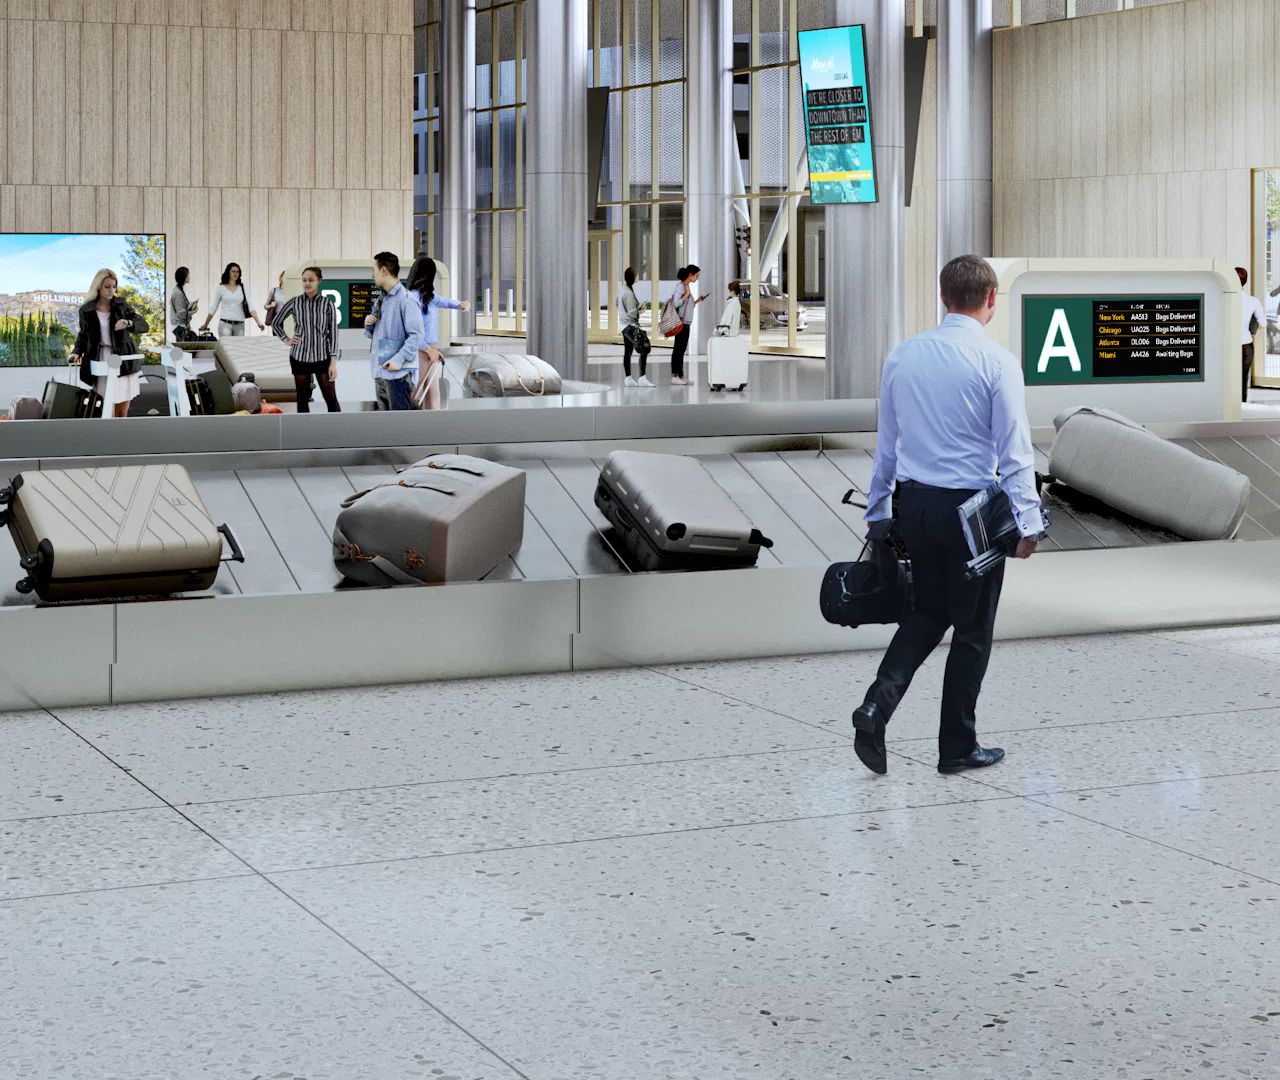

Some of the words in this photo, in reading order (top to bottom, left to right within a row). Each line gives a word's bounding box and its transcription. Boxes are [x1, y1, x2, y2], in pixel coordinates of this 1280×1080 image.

[828, 89, 852, 103] CLOSER
[853, 88, 863, 101] TO
[809, 109, 847, 124] DOWNTOWN
[848, 108, 866, 121] THAN
[810, 130, 824, 143] THE
[824, 129, 839, 142] REST
[840, 129, 849, 142] OF
[33, 294, 85, 303] HOLLYWOO
[1155, 313, 1169, 322] Bags
[1099, 326, 1121, 335] Chicago
[1155, 325, 1169, 334] Bags
[1170, 325, 1196, 333] Delivered
[1037, 308, 1081, 373] A
[1155, 338, 1169, 347] Bags
[1170, 337, 1196, 345] Delivered
[1099, 351, 1116, 359] Miami
[1155, 350, 1180, 359] Awaiting
[1180, 350, 1194, 358] Bags
